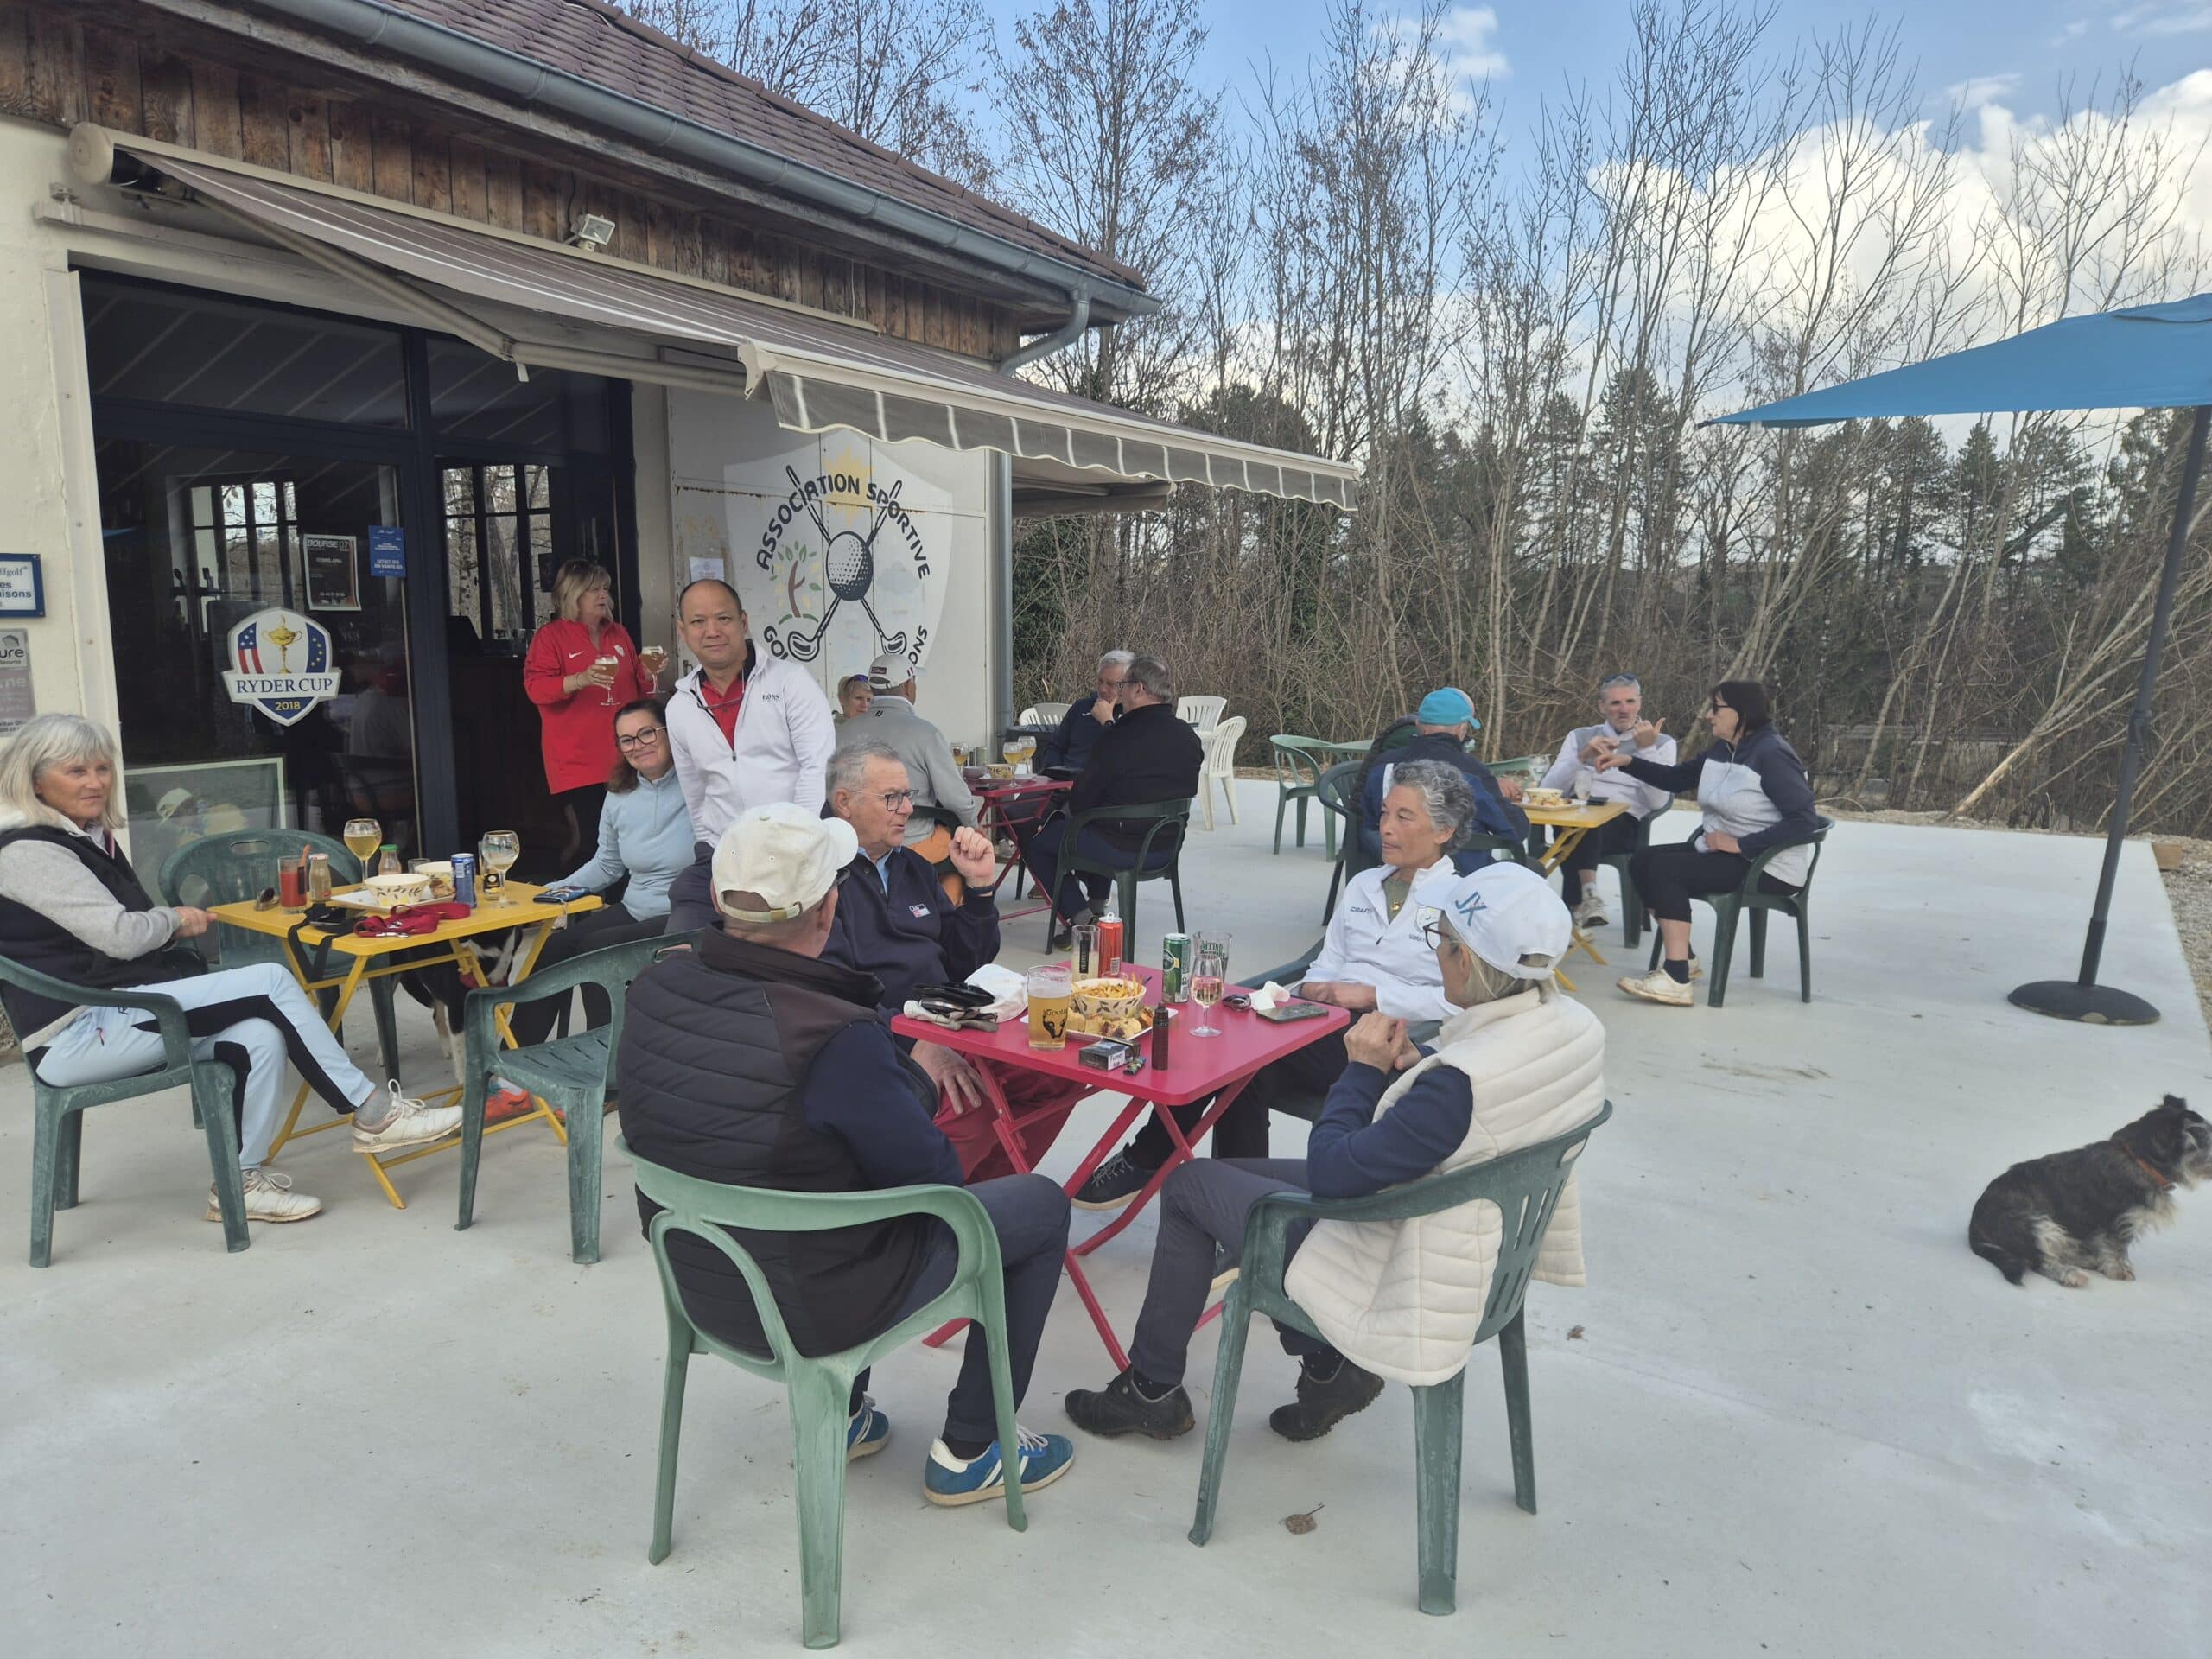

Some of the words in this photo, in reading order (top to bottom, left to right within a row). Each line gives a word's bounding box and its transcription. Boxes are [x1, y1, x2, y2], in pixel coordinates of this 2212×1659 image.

[757, 474, 860, 570] ASSOCIATION
[866, 482, 931, 579] SPORTIVE
[307, 539, 338, 548] BOURSE
[908, 625, 928, 665] ONS
[0, 648, 24, 658] ure
[236, 679, 296, 693] RYDER
[298, 677, 333, 691] CUP
[275, 701, 301, 711] 2018
